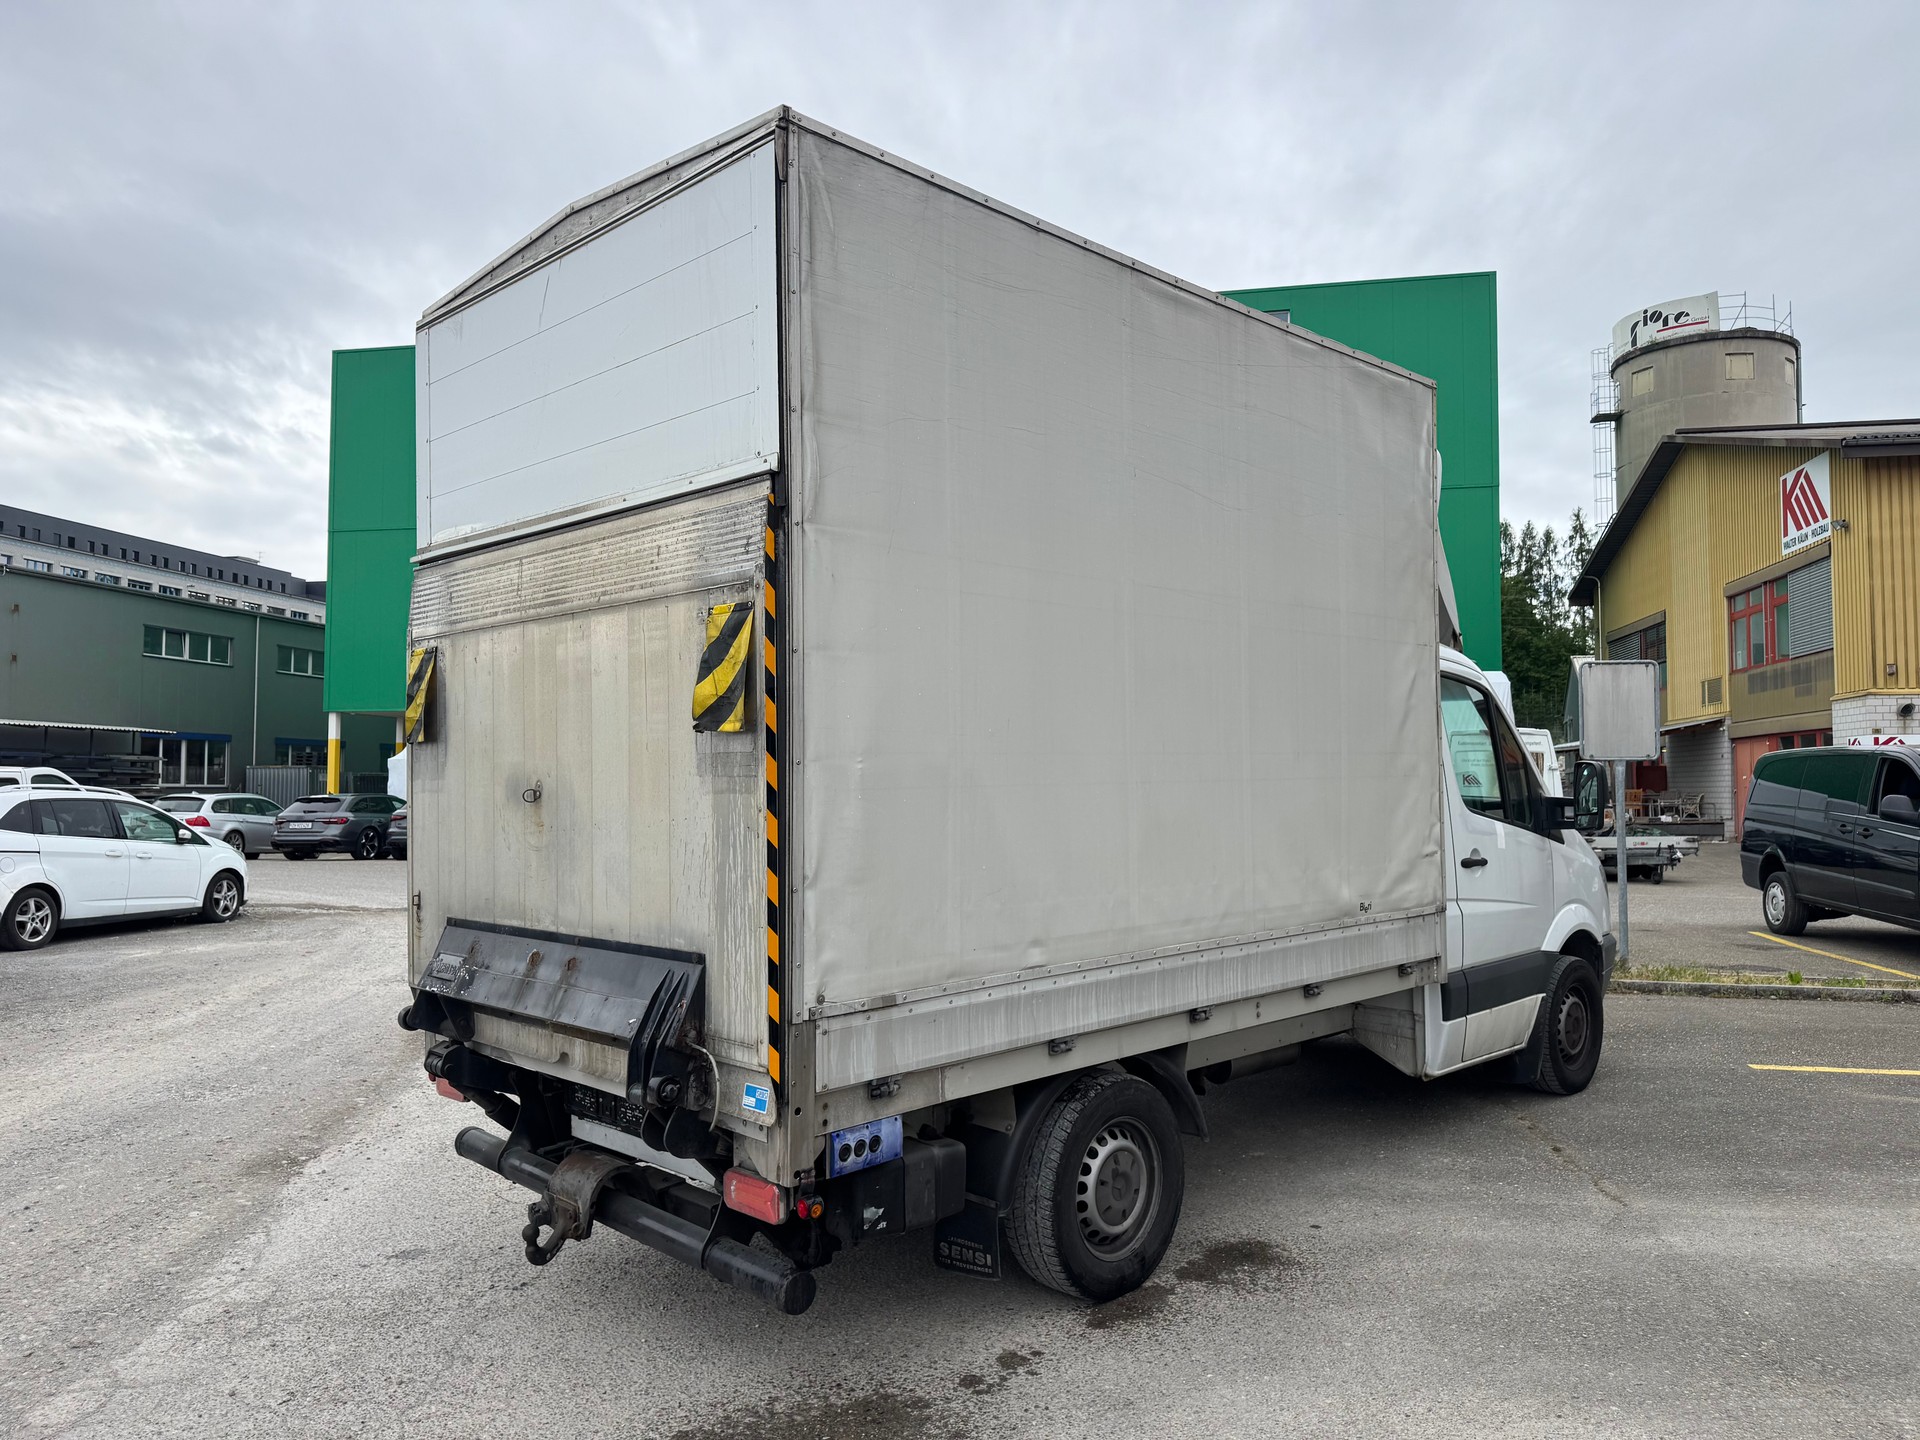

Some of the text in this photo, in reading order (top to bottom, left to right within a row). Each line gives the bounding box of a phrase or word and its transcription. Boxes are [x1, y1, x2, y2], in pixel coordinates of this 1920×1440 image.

[1783, 537, 1797, 551] WALTER
[1811, 522, 1829, 538] HOLZBAU
[940, 1242, 991, 1266] SENSI
